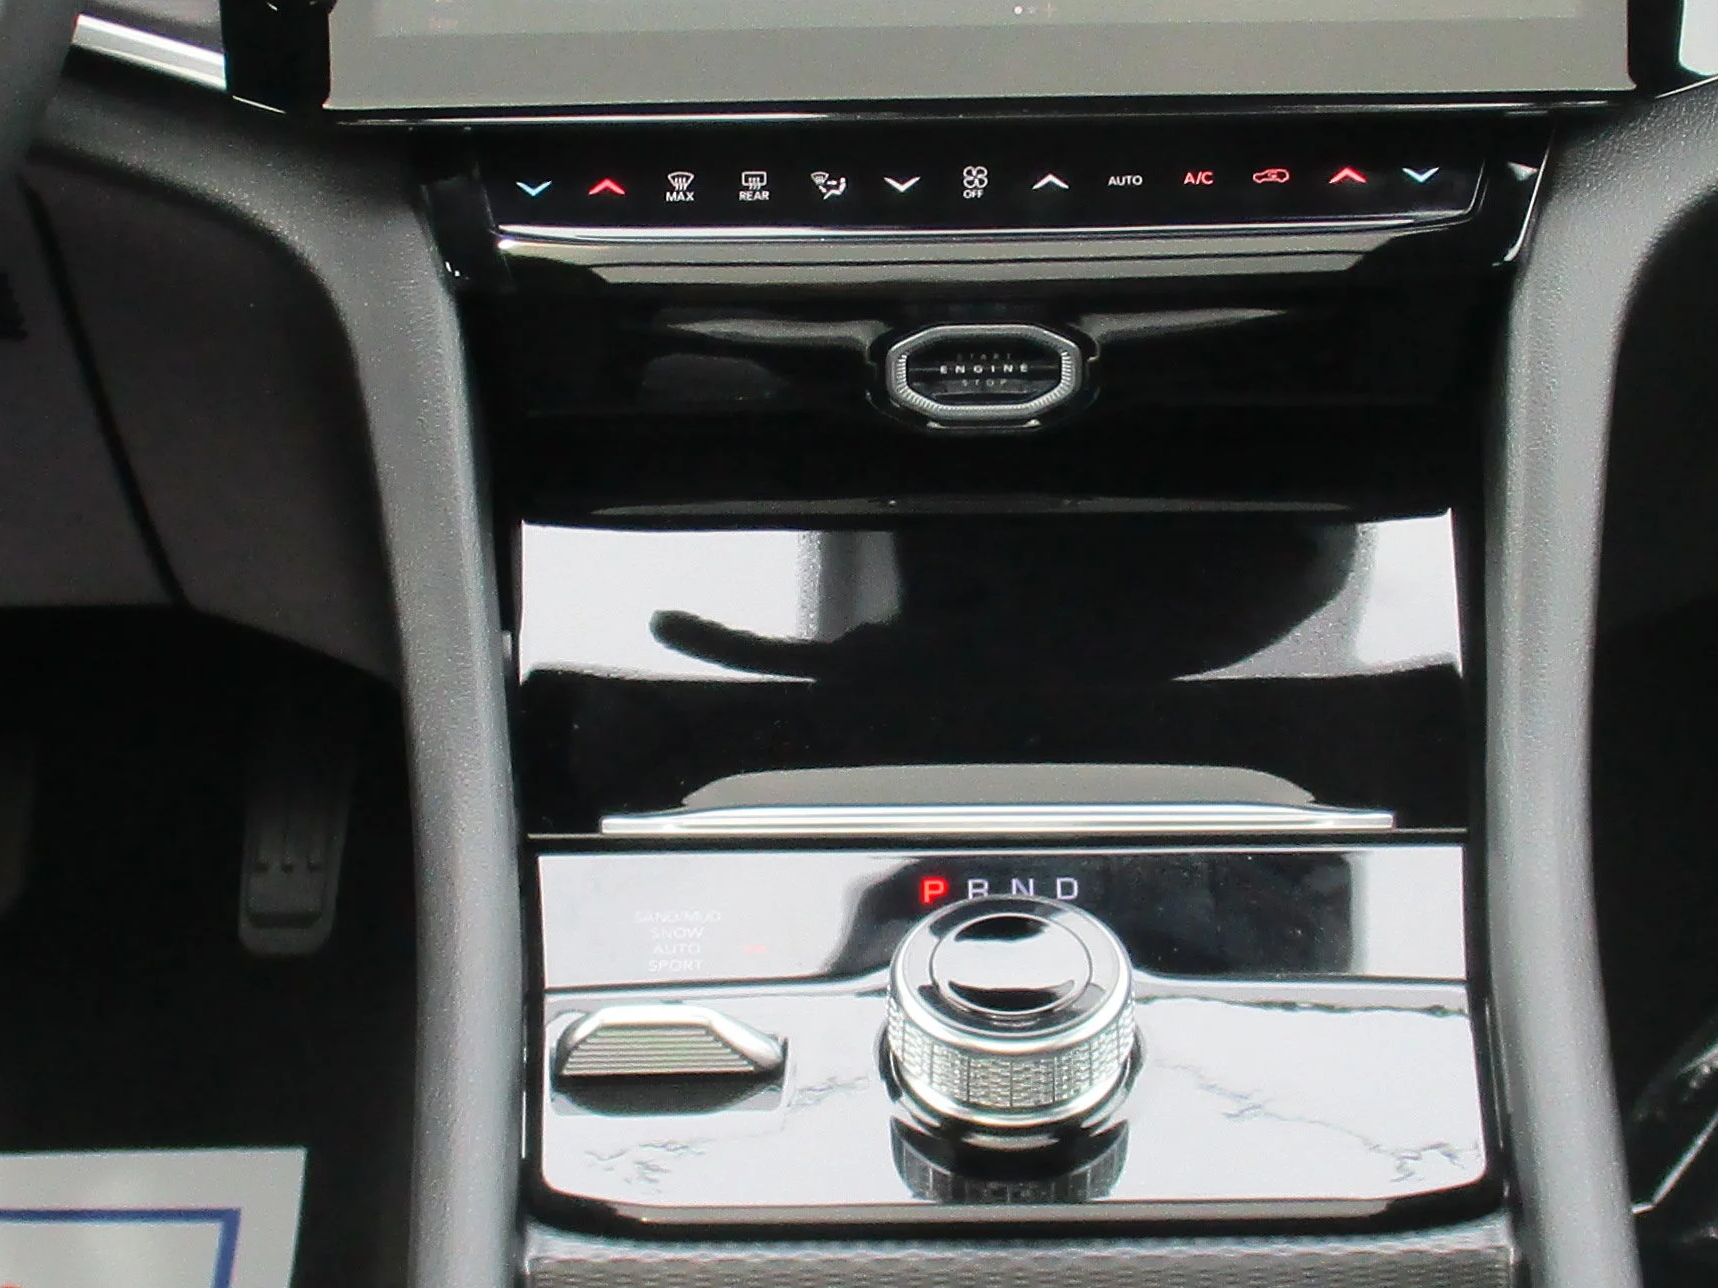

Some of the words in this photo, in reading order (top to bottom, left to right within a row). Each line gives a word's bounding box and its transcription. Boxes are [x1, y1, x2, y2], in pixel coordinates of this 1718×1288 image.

[1107, 174, 1143, 187] AUTO
[1183, 171, 1214, 185] A/C
[665, 191, 695, 202] MAX
[738, 190, 770, 201] REAR
[963, 188, 983, 199] OFF
[940, 363, 1029, 374] ENGINE
[962, 378, 1008, 387] STOP
[920, 877, 948, 905] P
[967, 878, 989, 900] R
[1011, 877, 1034, 896] N
[1056, 877, 1079, 900] D
[650, 926, 705, 940] SNOW
[652, 942, 701, 956] AUTO
[647, 958, 705, 972] SPORT
